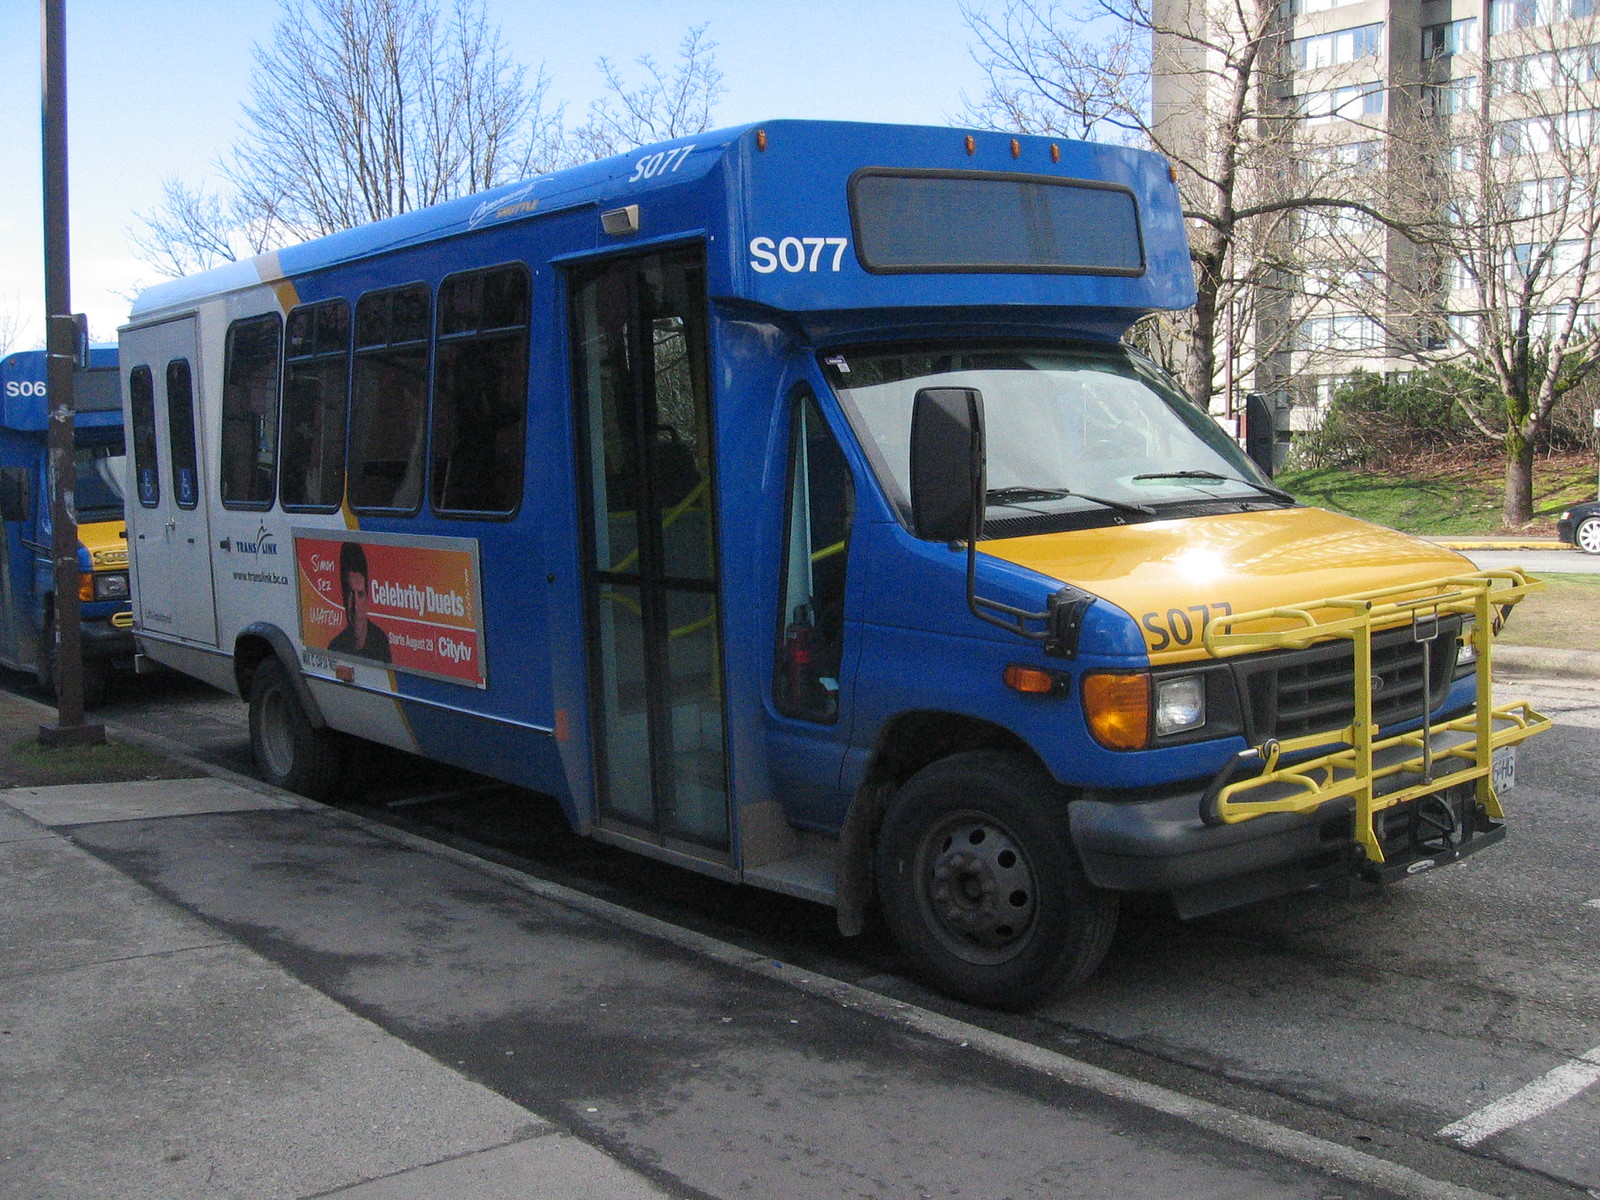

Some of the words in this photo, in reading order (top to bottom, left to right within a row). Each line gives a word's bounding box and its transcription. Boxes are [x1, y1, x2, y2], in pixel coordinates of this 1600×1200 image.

[628, 144, 697, 183] S077
[749, 236, 848, 274] S077
[6, 381, 47, 397] S06
[310, 553, 335, 573] Simon
[371, 579, 425, 617] Celebrity
[425, 586, 465, 617] Duets
[406, 634, 426, 651] August
[1141, 602, 1232, 651] S077
[438, 636, 472, 664] Citytv
